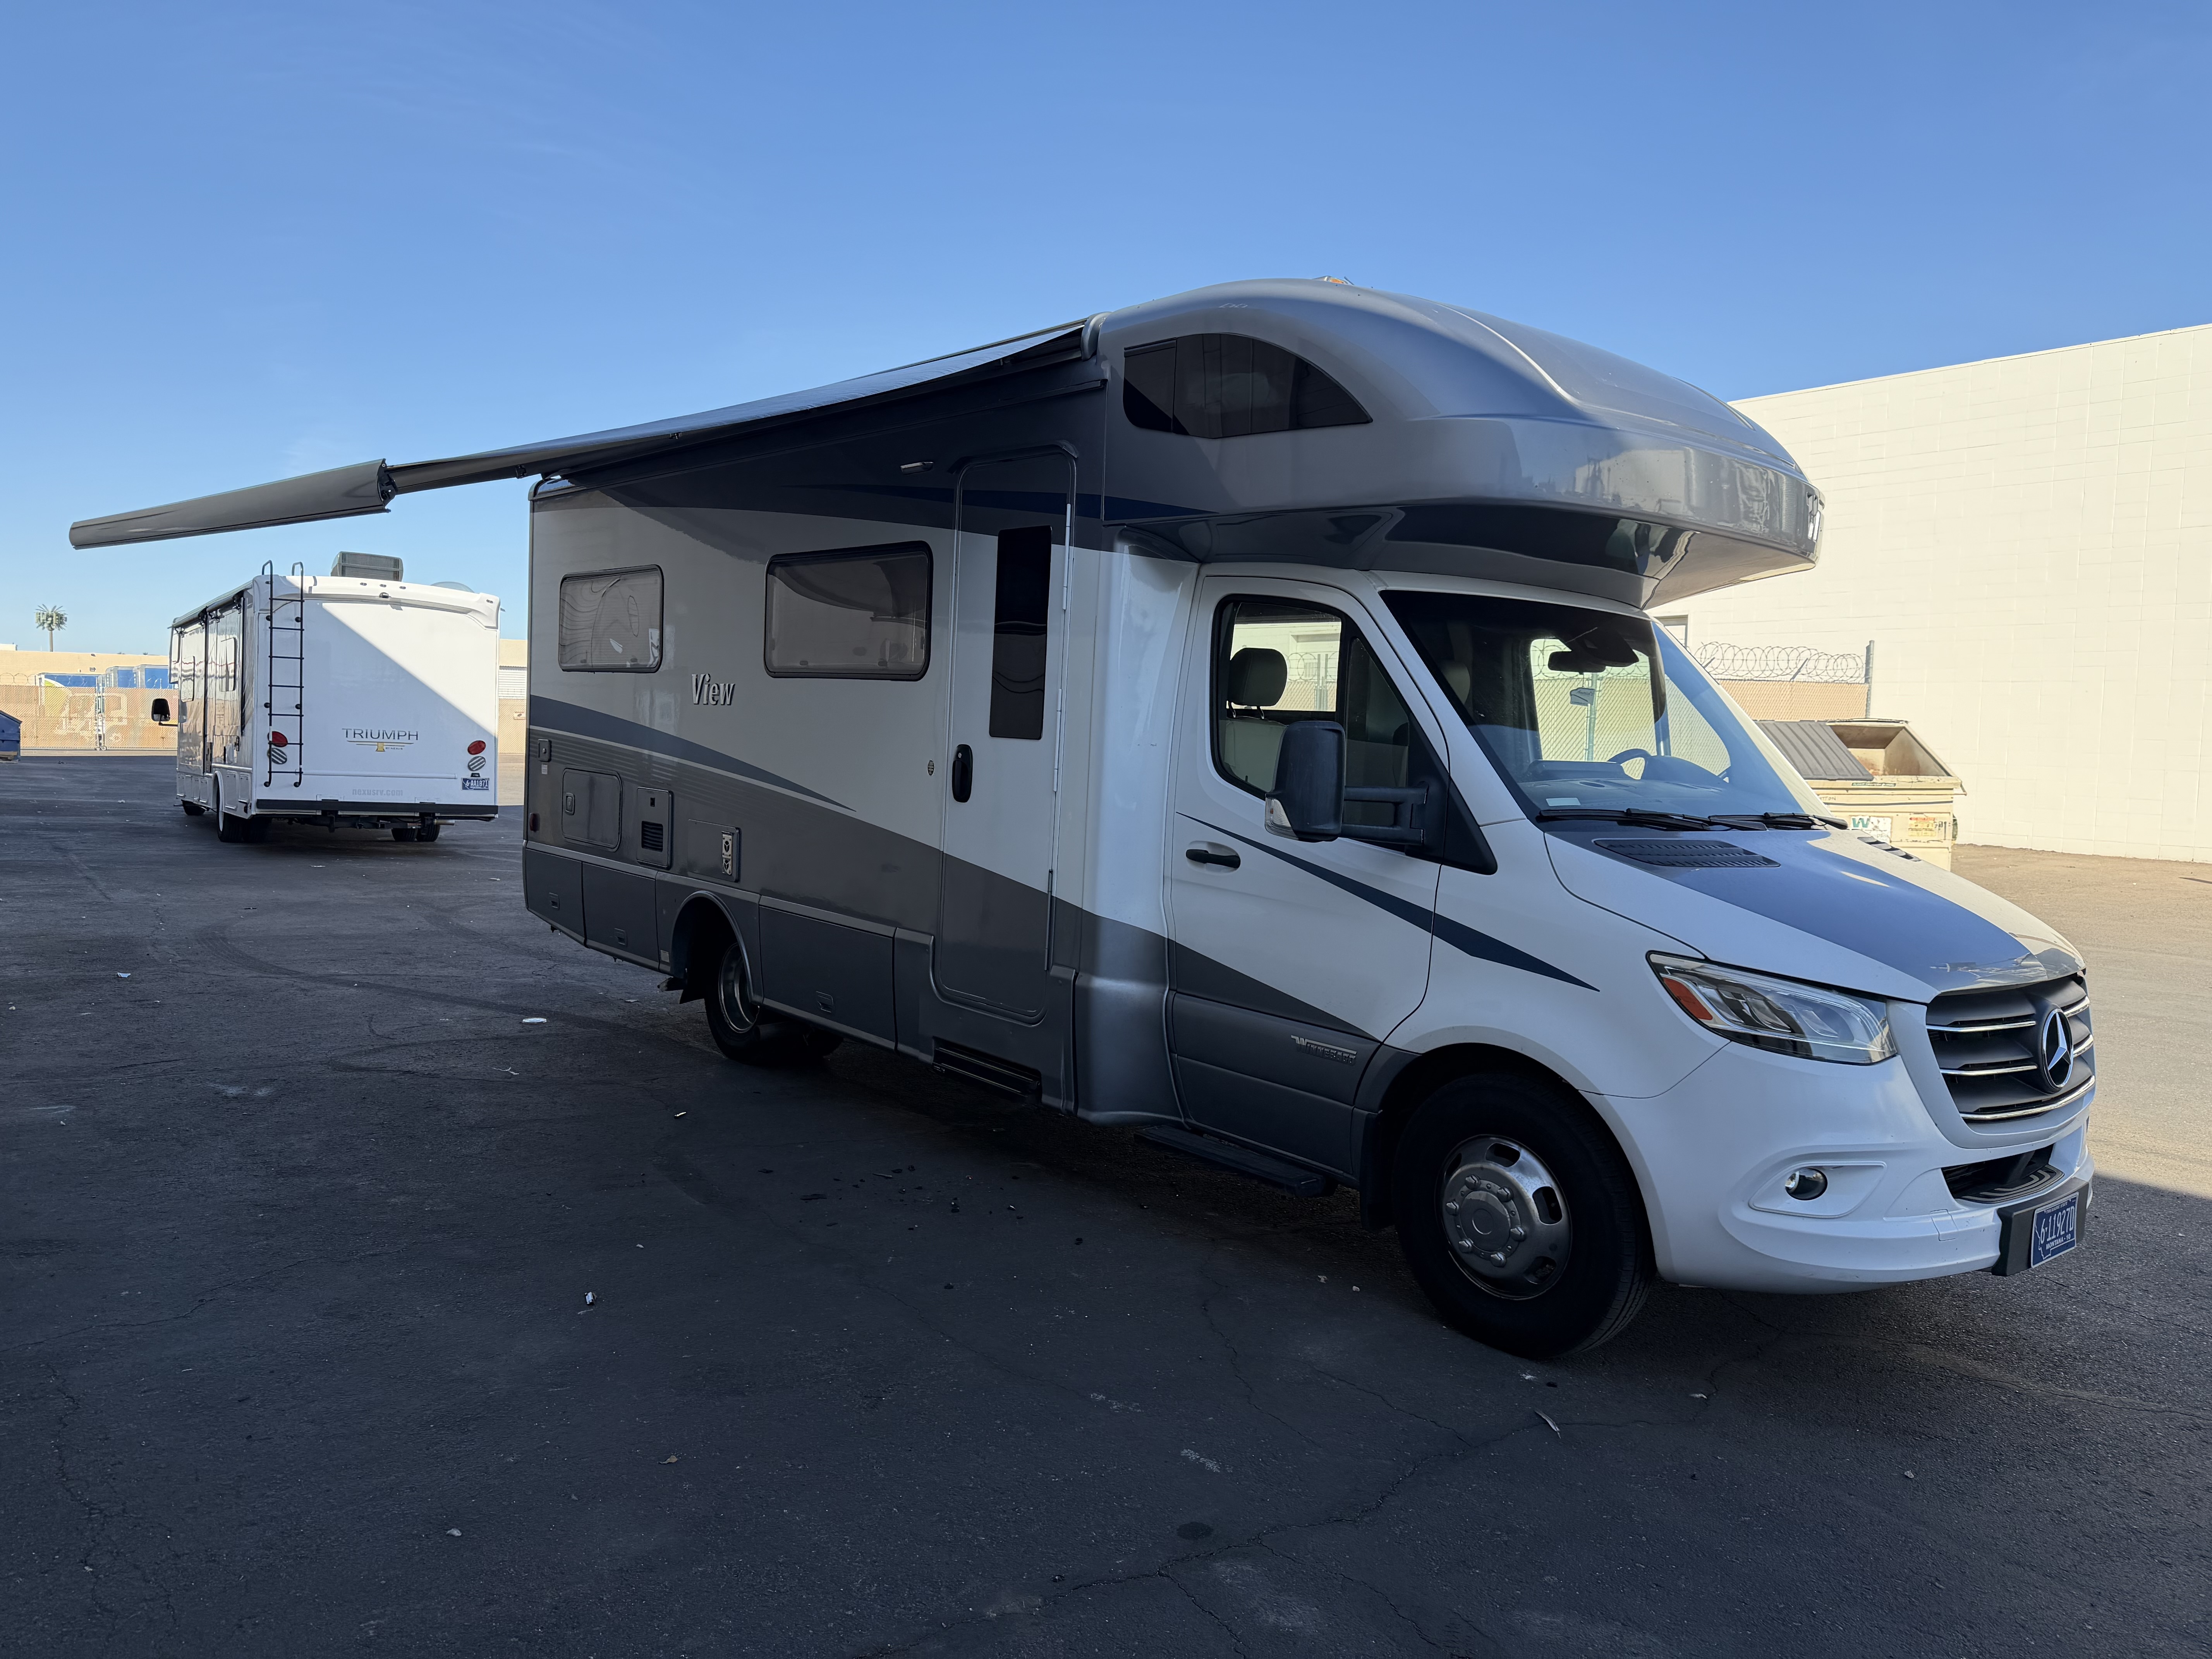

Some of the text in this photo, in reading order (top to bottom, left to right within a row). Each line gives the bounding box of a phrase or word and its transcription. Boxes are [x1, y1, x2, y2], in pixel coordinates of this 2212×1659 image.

[692, 673, 735, 706] View
[342, 728, 418, 740] TRIUMPH
[1291, 1035, 1357, 1066] WINNEBAGO
[2040, 1206, 2075, 1244] 6-11927D
[2046, 1237, 2064, 1250] MONTANA
